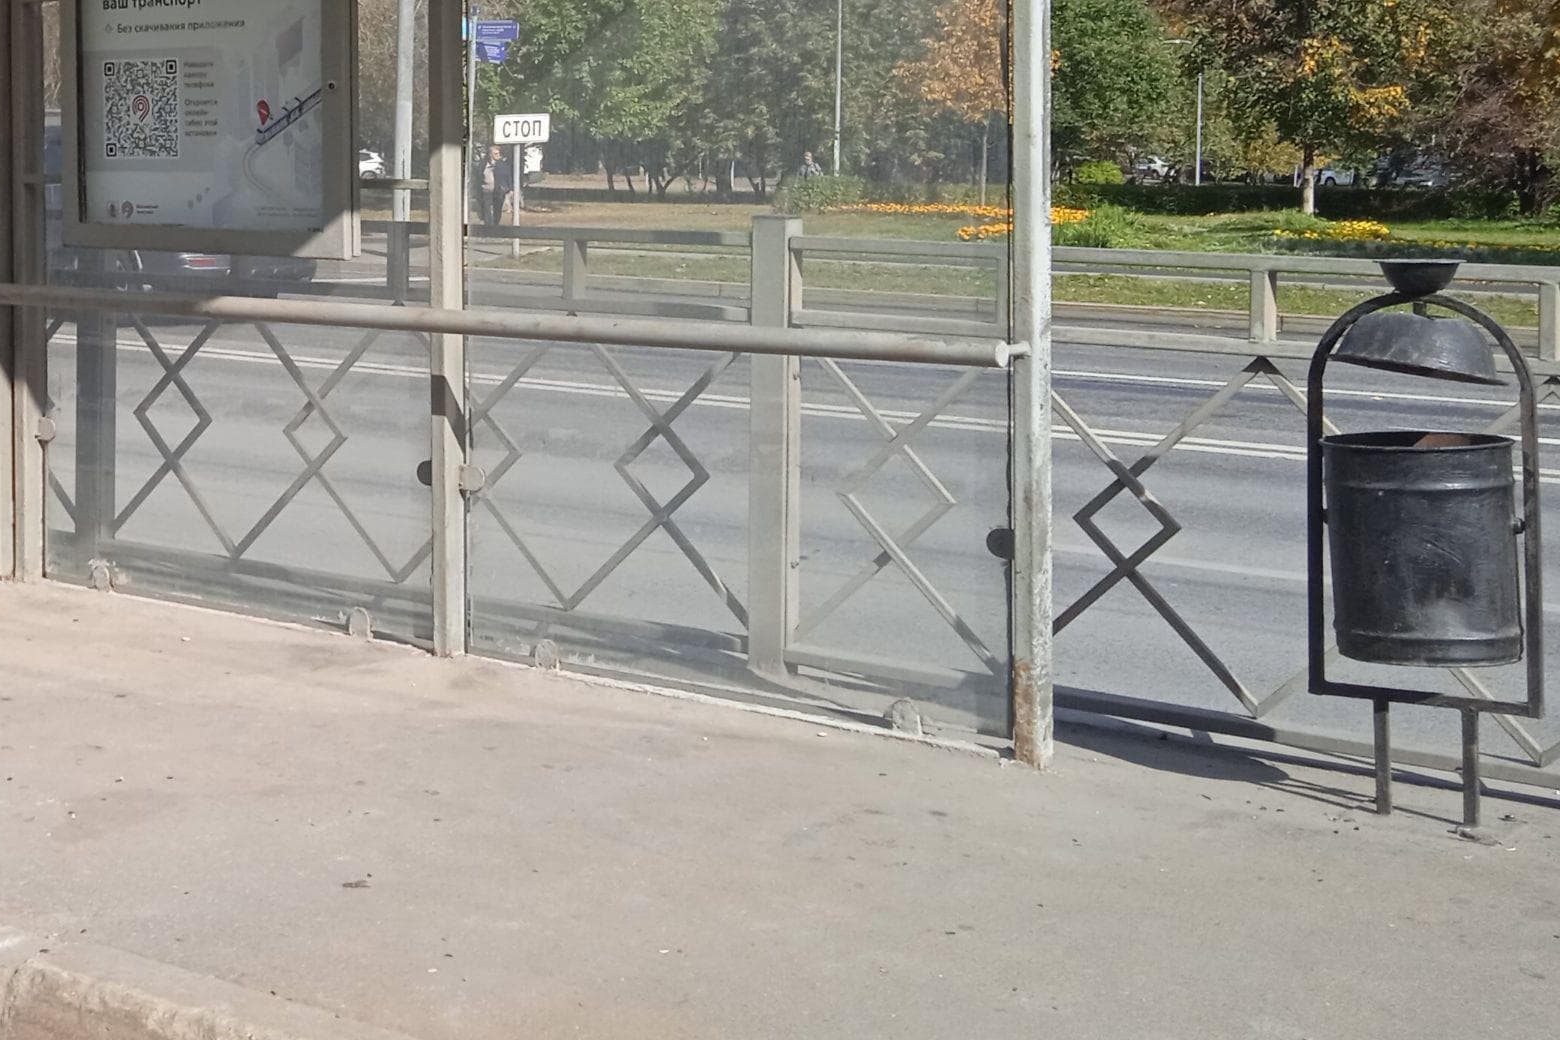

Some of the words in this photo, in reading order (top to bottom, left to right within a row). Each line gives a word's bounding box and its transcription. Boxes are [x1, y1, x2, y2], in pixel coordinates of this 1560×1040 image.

[117, 23, 132, 33] Без
[134, 21, 185, 33] скачивания
[502, 120, 542, 138] СТОП
